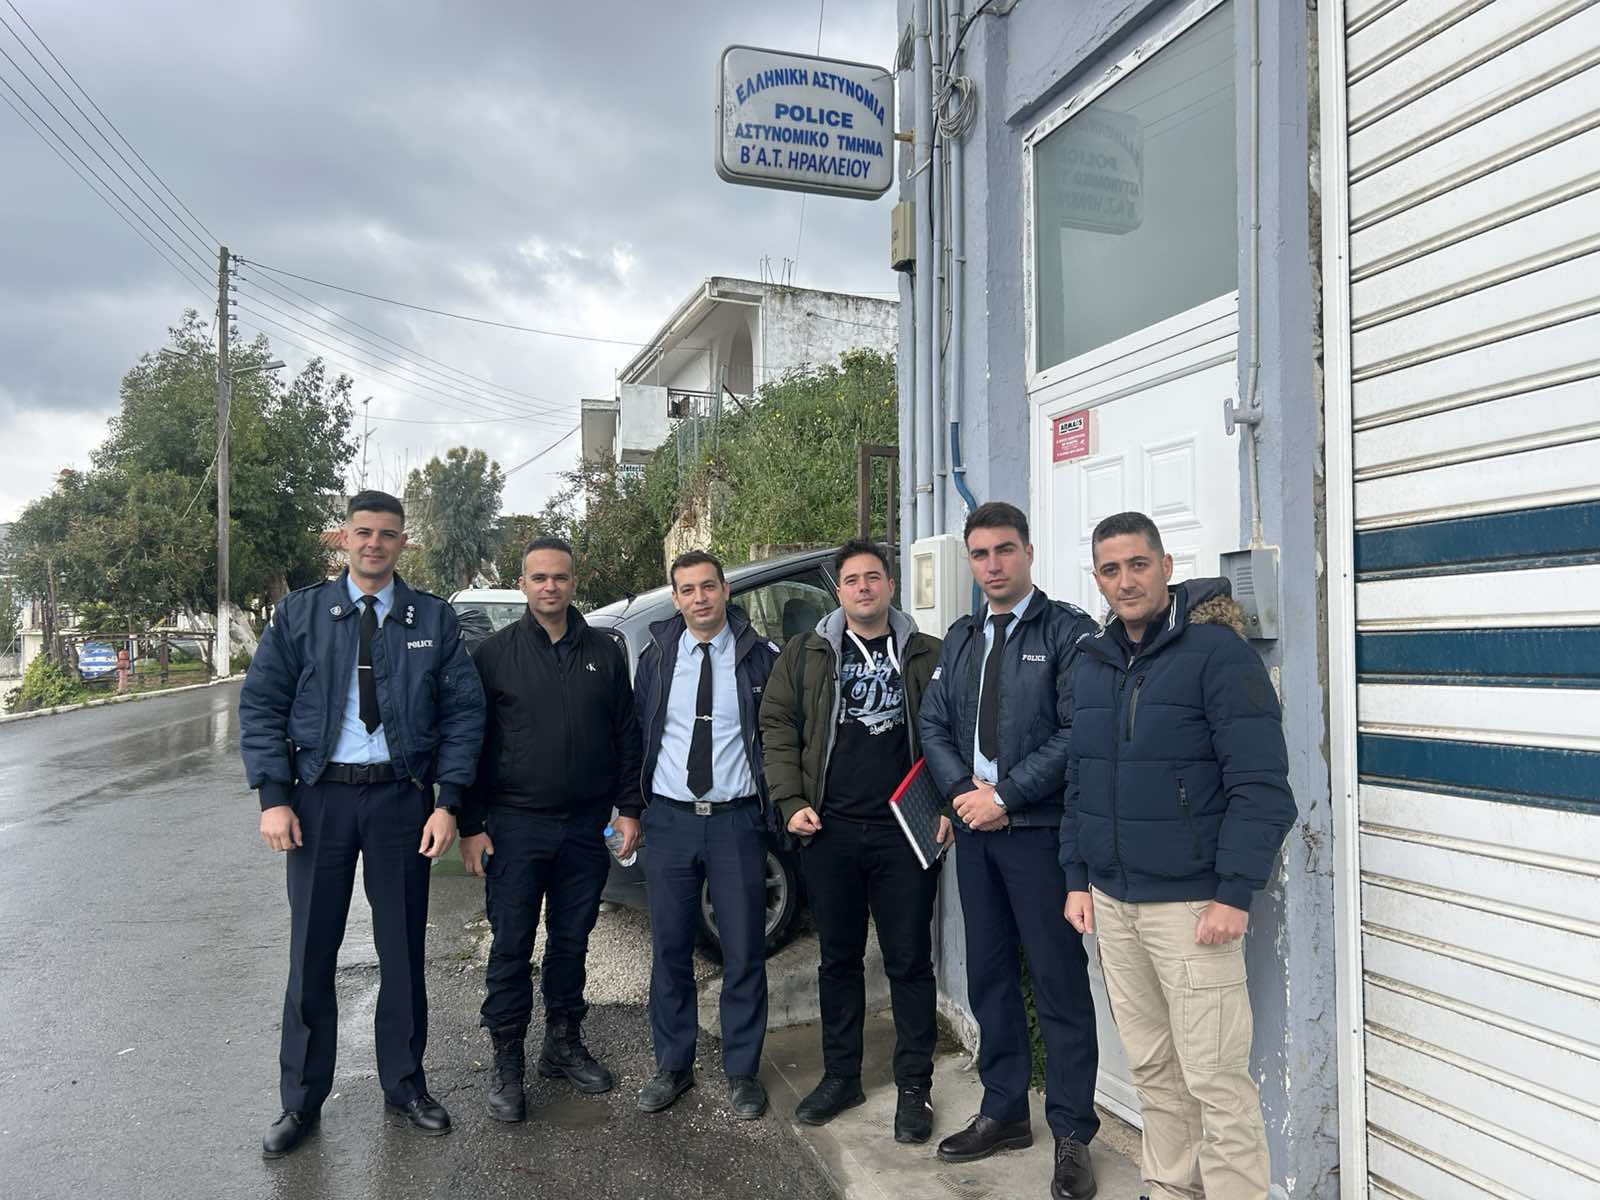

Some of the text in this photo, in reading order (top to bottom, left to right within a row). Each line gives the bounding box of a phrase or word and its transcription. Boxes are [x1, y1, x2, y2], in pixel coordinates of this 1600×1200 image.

[735, 68, 885, 127] ΕΛΛΗΝΙΚΗ ΑΣΤΥΝΟΜΙΑ
[775, 103, 853, 129] POLICE
[735, 123, 883, 157] ΑΣΤΥΝΟΜΙΚΟ ΤΜΗΜΑ
[788, 151, 871, 179] ΗΡΑΚΛΕΙΟΥ
[407, 640, 433, 649] POLICE
[1022, 654, 1046, 662] POLICE
